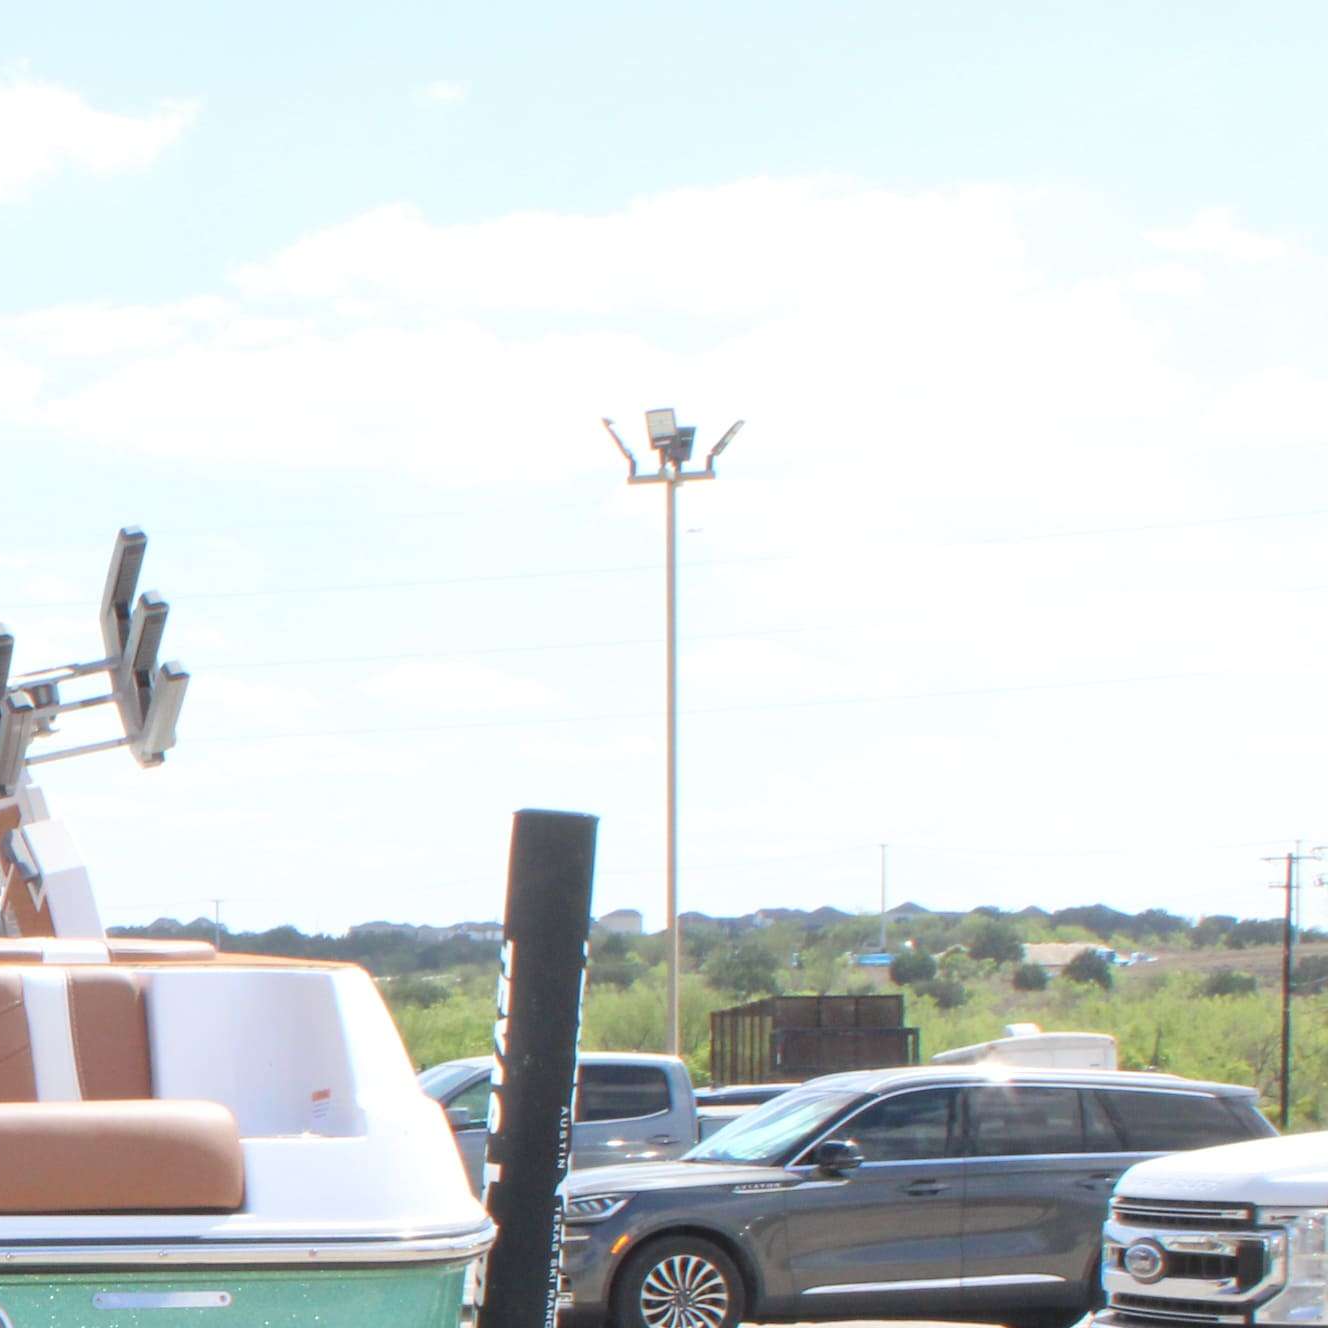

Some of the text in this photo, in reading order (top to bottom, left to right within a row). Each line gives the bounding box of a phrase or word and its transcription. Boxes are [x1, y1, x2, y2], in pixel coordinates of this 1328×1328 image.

[557, 1106, 570, 1170] AUSTIN
[551, 1206, 563, 1252] TEXAS
[548, 1256, 558, 1284] SKI
